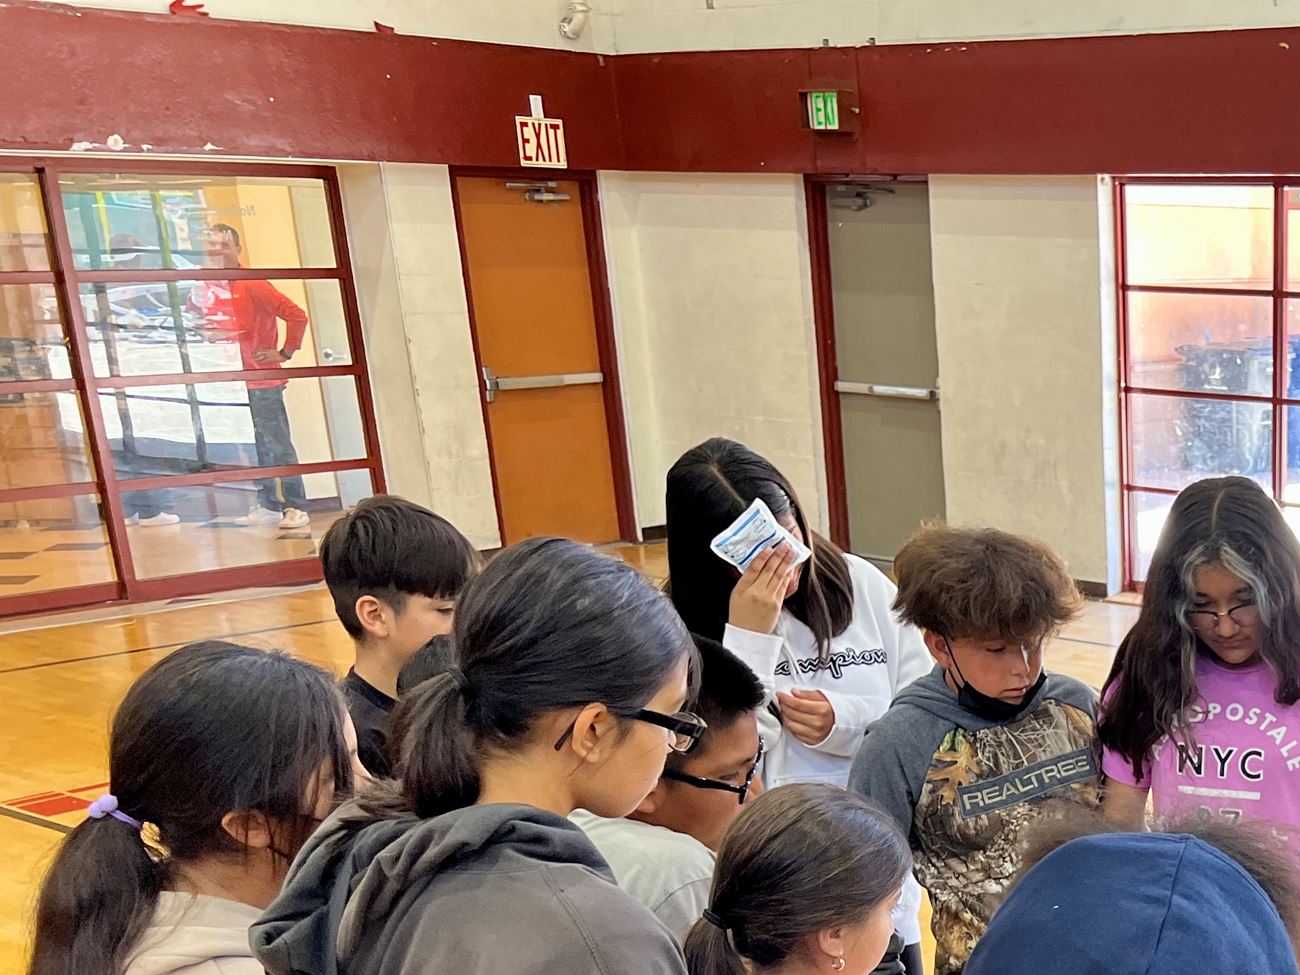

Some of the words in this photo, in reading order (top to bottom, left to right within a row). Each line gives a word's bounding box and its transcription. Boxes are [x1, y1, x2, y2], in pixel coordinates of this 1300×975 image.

[519, 121, 561, 163] EXIT
[963, 755, 1090, 809] REALTREE
[1176, 741, 1265, 782] NYC
